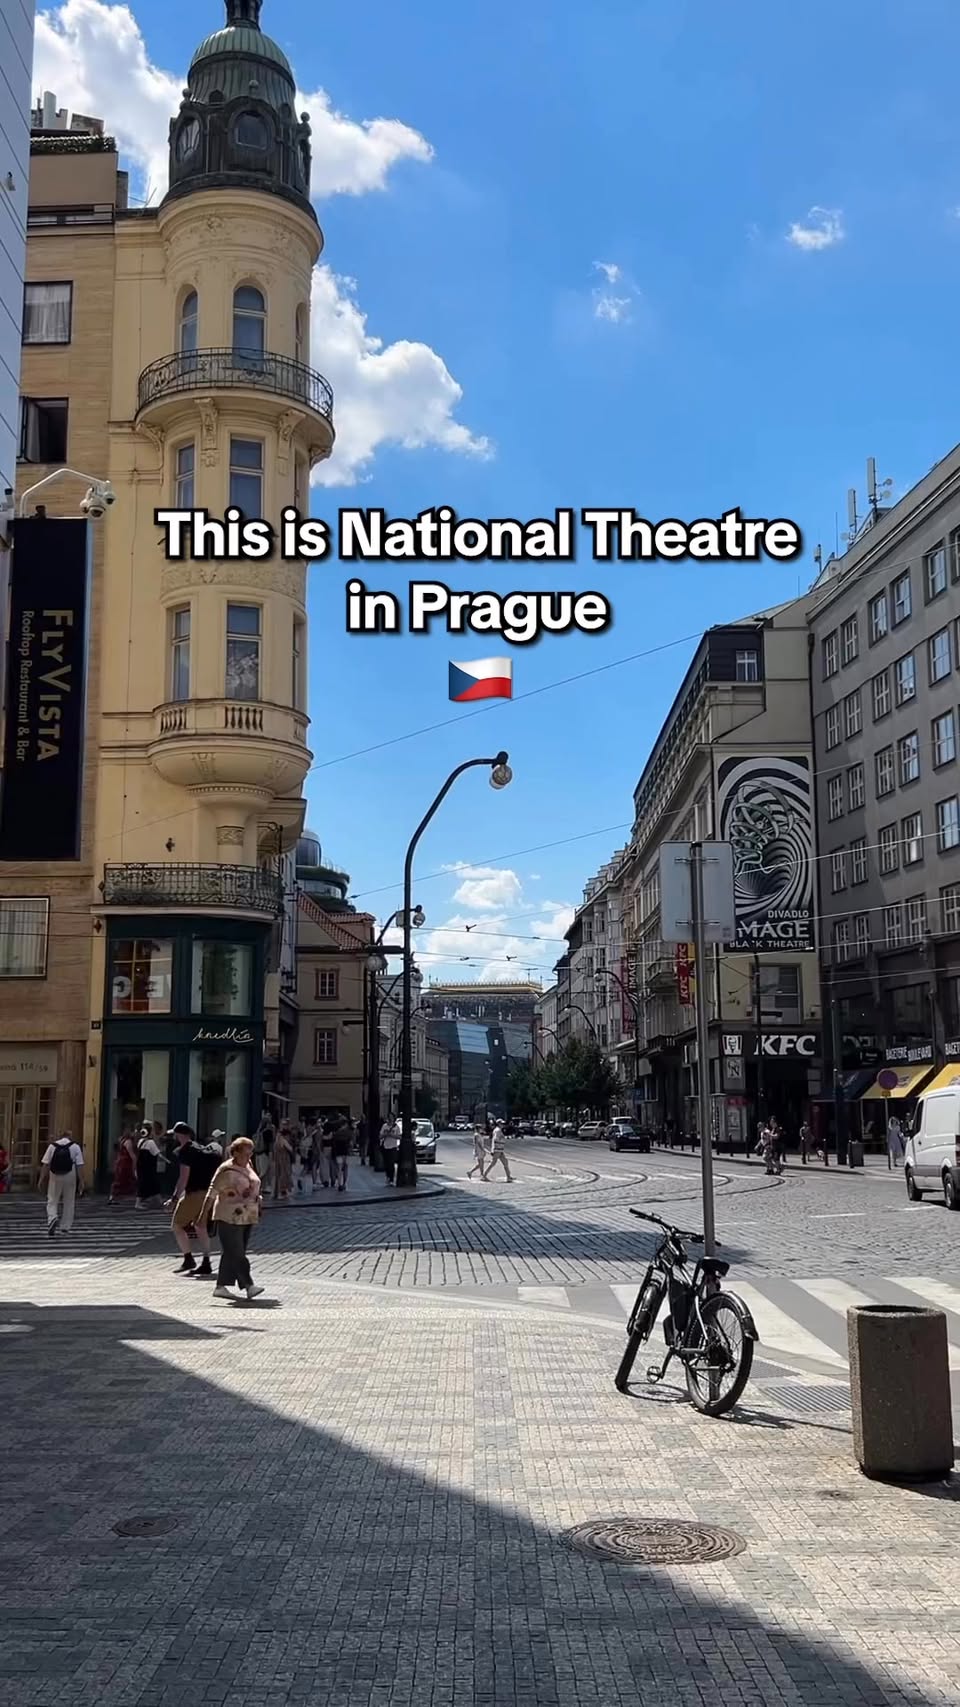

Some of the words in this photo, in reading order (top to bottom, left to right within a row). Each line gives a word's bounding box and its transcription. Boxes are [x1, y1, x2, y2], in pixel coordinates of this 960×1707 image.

[17, 610, 35, 657] Rooftop
[18, 660, 33, 723] Restaurant
[17, 727, 30, 736] &
[16, 740, 30, 761] Bar
[767, 909, 809, 919] DIVADLO
[737, 920, 810, 938] MAGE
[729, 940, 763, 948] BLAK
[766, 940, 810, 949] THEATRE
[680, 975, 689, 998] KFC
[754, 1034, 817, 1056] KFC
